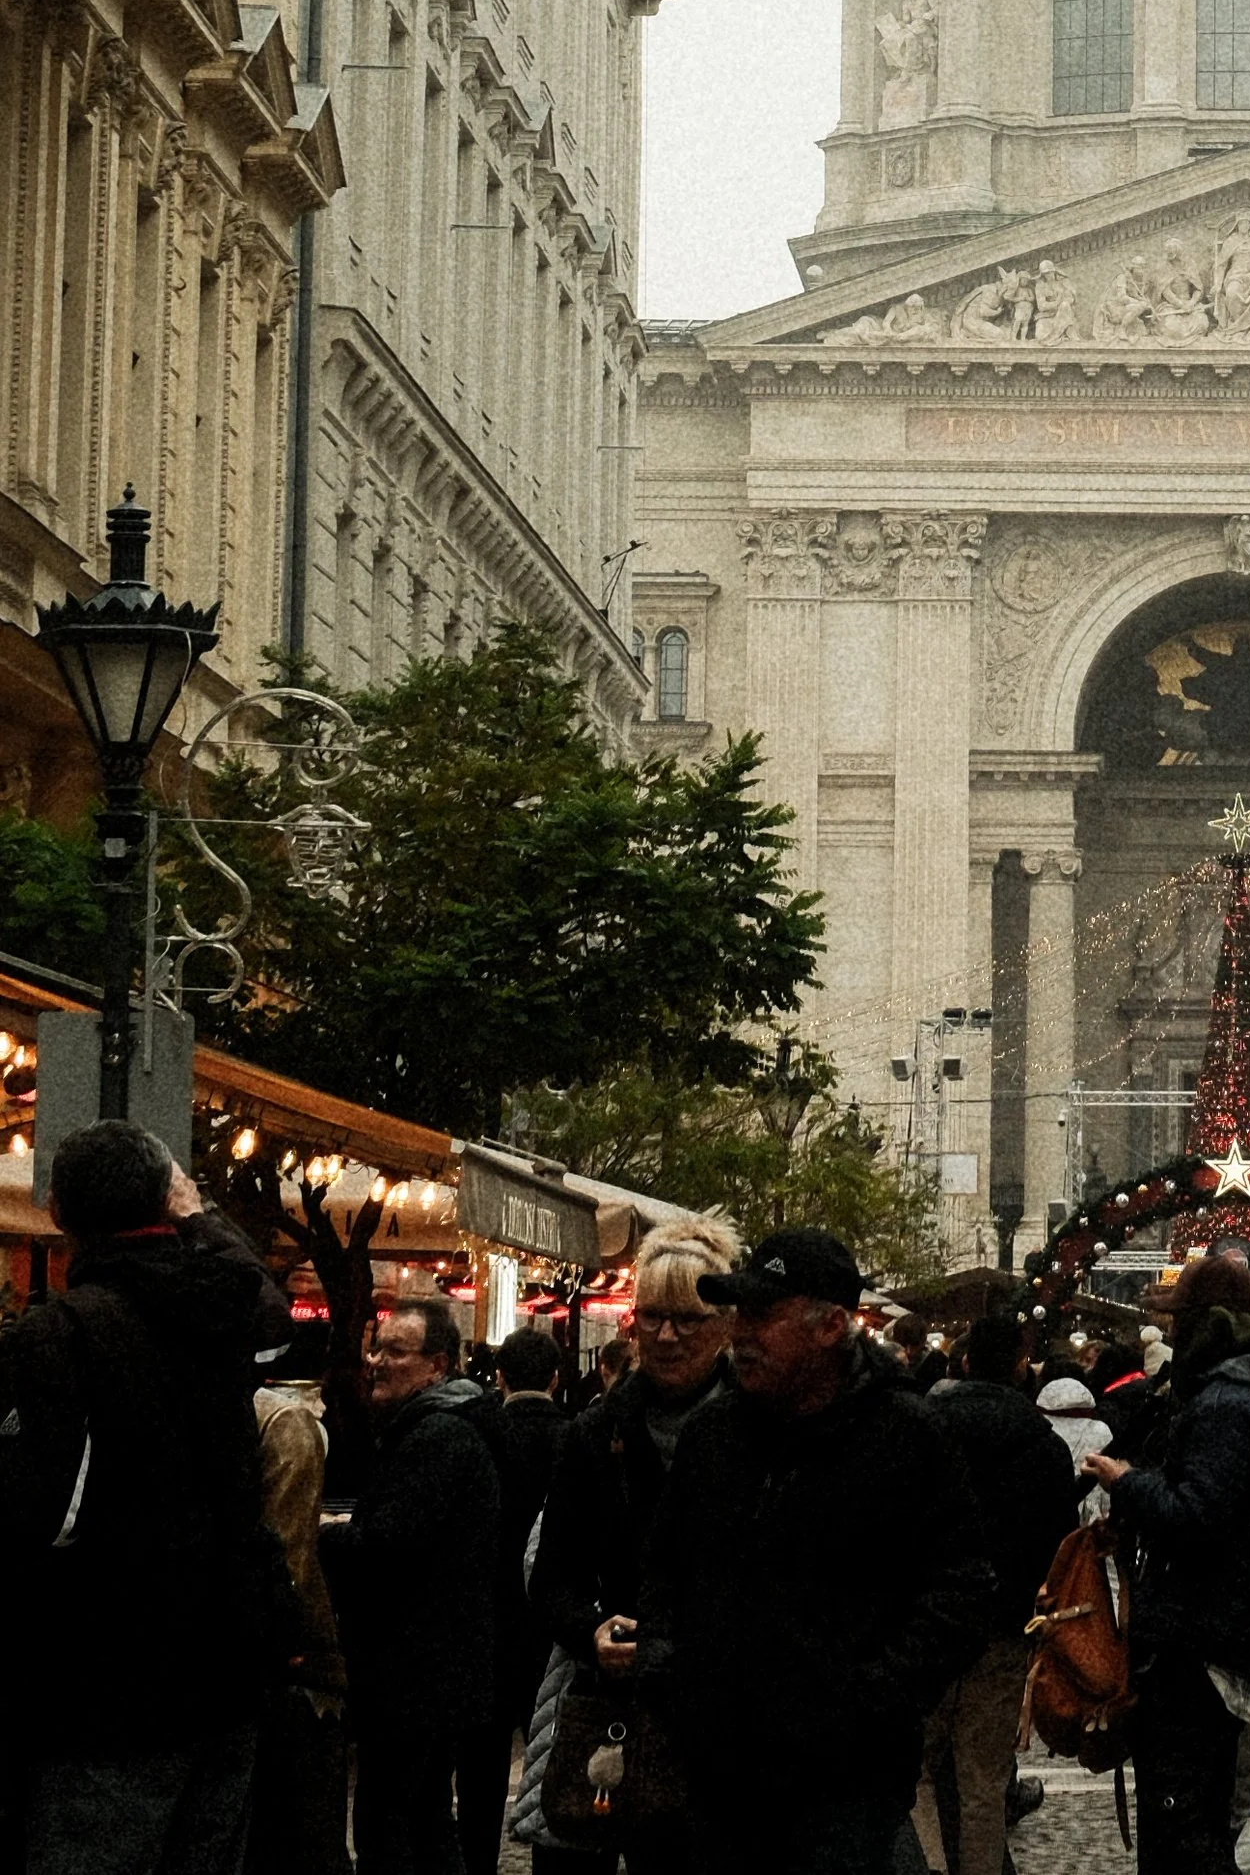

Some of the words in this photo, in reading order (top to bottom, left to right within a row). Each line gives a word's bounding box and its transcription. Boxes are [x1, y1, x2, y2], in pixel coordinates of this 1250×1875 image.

[944, 417, 1018, 445] EGO
[1046, 418, 1122, 446] SUM
[1150, 418, 1212, 446] VIA
